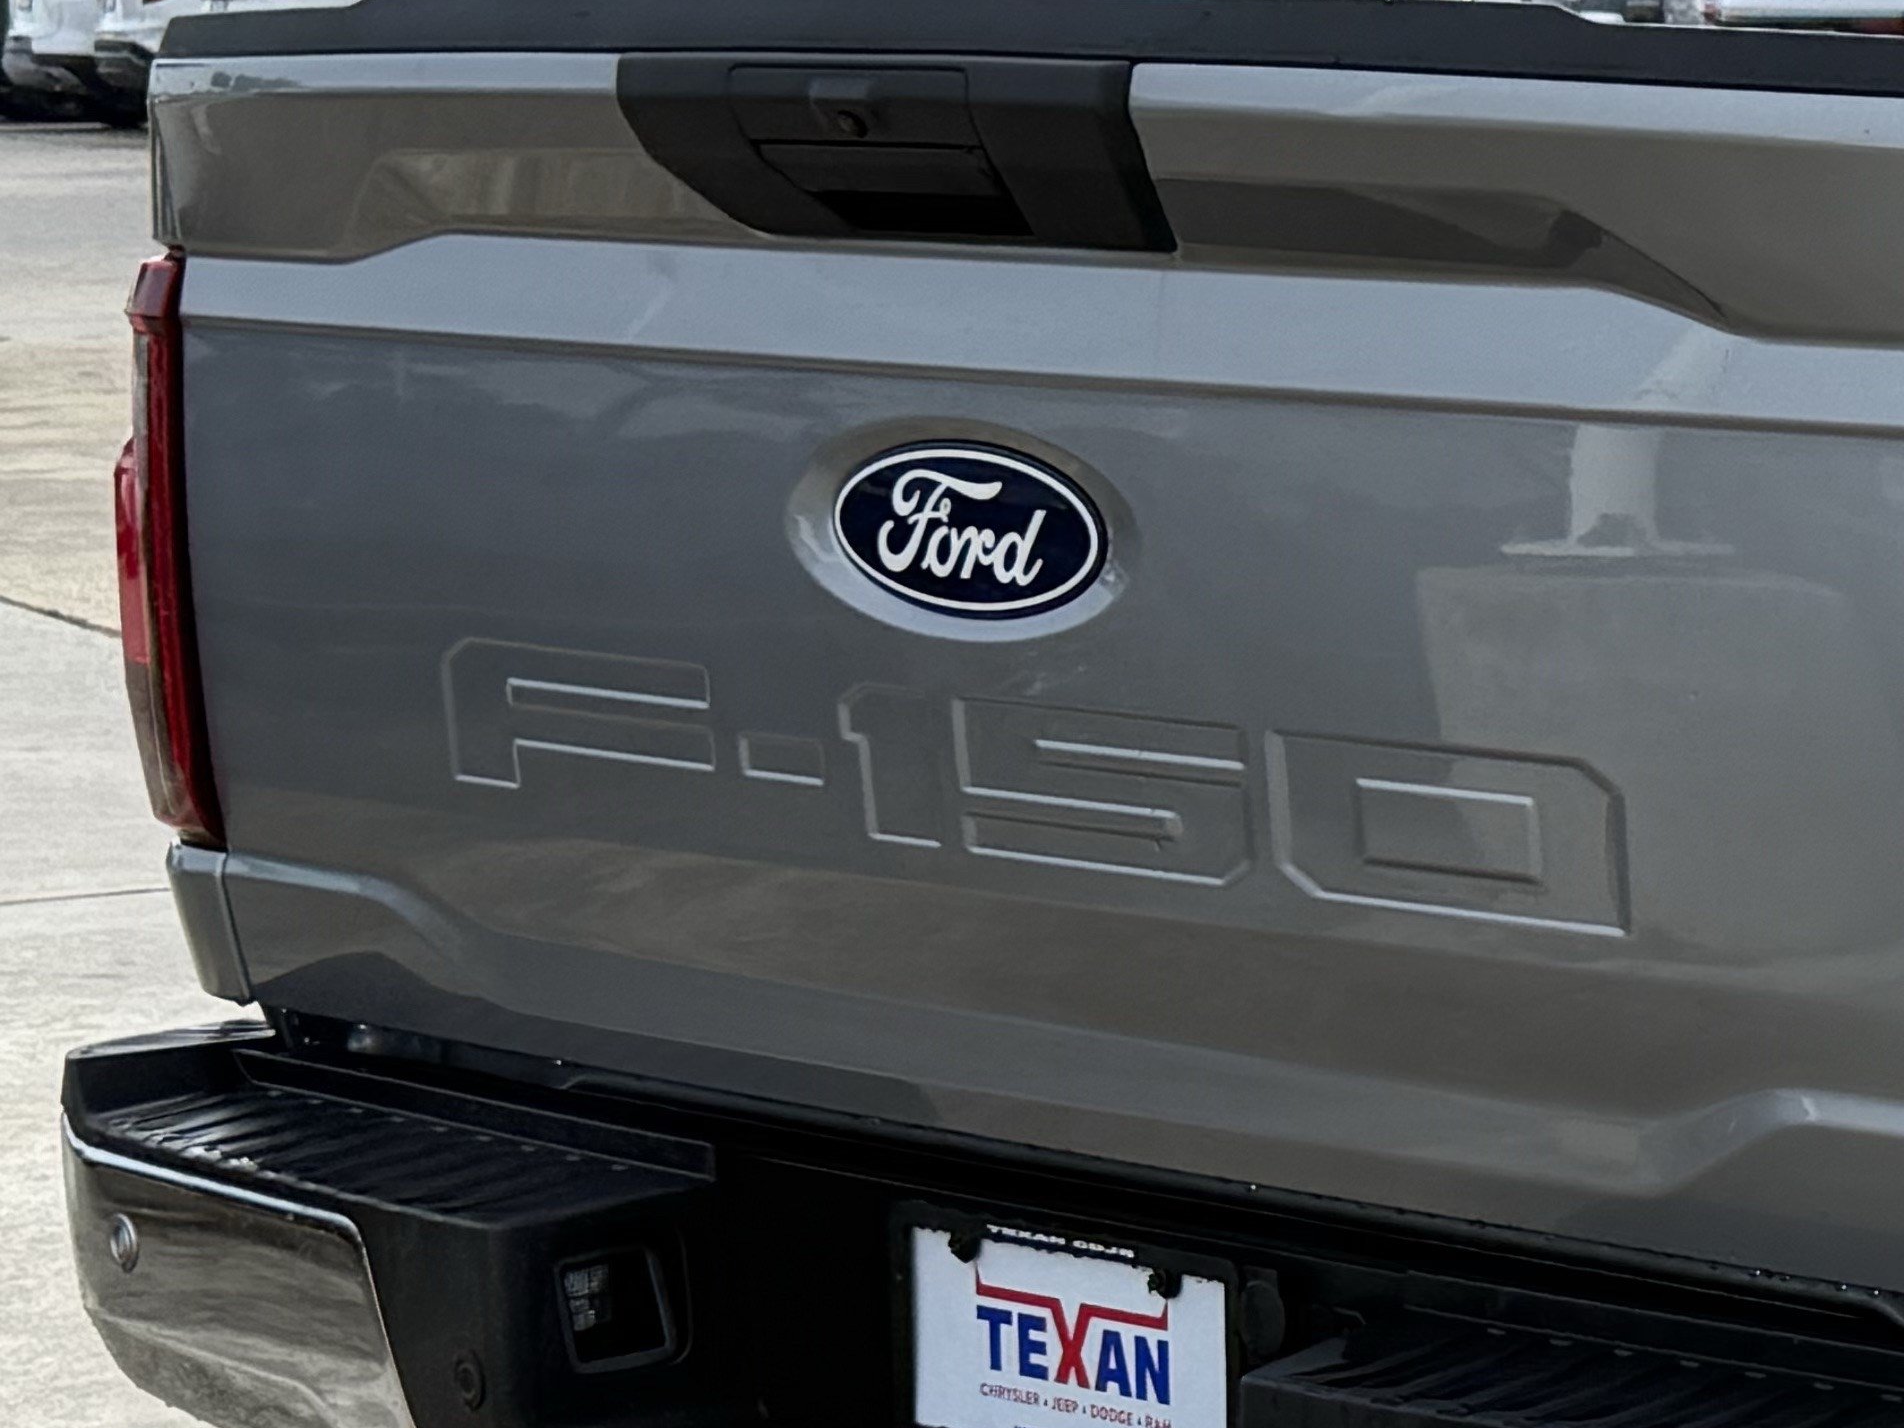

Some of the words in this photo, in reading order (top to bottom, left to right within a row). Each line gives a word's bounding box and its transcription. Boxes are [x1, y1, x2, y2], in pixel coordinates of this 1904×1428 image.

[877, 467, 1047, 586] Ford
[442, 636, 1630, 936] F-150
[975, 1297, 1172, 1406] TEXAN
[980, 1382, 1041, 1406] CHRYSLER
[1051, 1396, 1080, 1415] JEEP
[1090, 1403, 1134, 1427] DODGE
